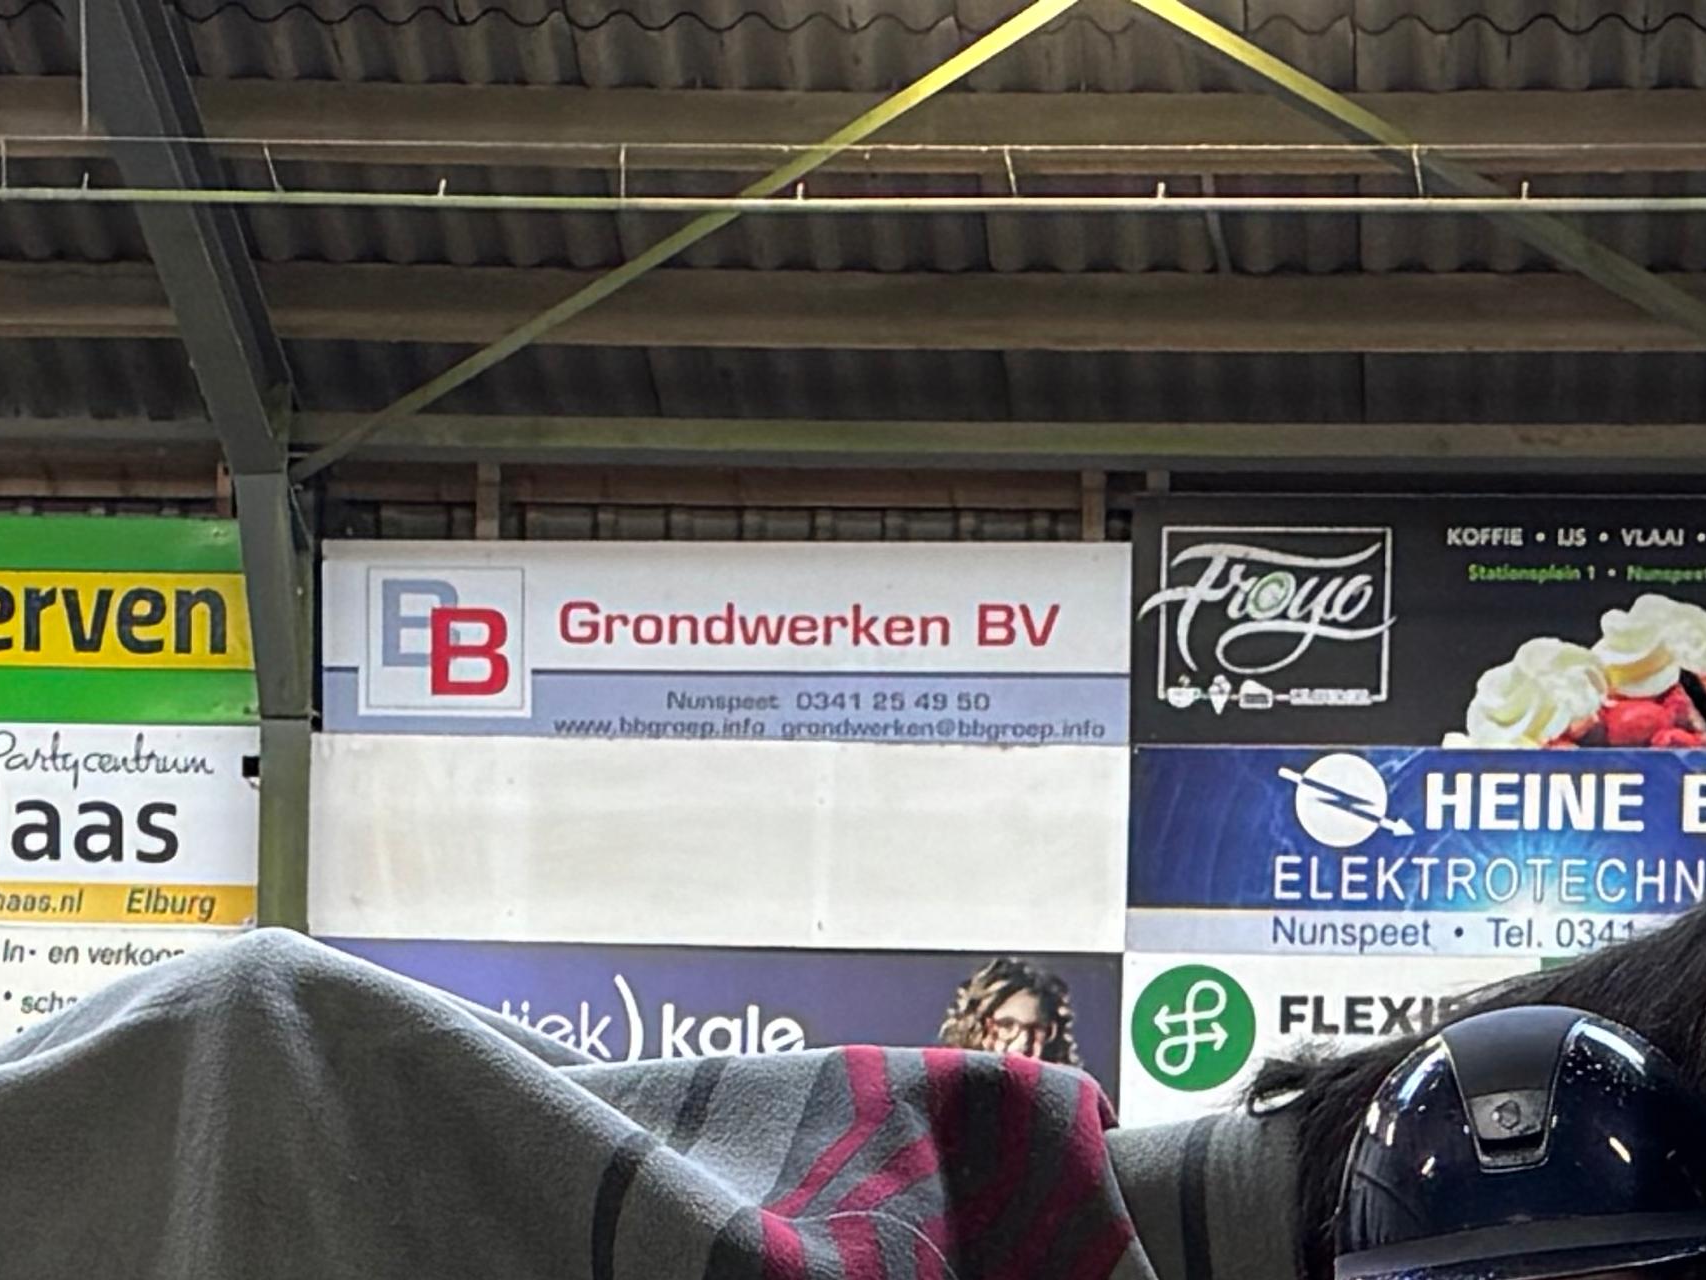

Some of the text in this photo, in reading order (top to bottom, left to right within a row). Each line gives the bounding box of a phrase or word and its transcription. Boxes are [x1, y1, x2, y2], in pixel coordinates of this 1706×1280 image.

[1446, 527, 1524, 547] KOFFIE
[1557, 527, 1587, 547] IJS
[1620, 527, 1684, 547] VLAAI
[558, 600, 1061, 648] Grondwerken BV
[667, 690, 991, 713] Nunspeet 0341 25 49 50
[780, 718, 1106, 741] grondwerken@bbgroep.info
[1425, 772, 1644, 833] HEINE
[125, 887, 217, 920] Elburg
[1272, 916, 1431, 954] Nunspeet
[1486, 917, 1543, 949] Tel.
[48, 944, 79, 965] en
